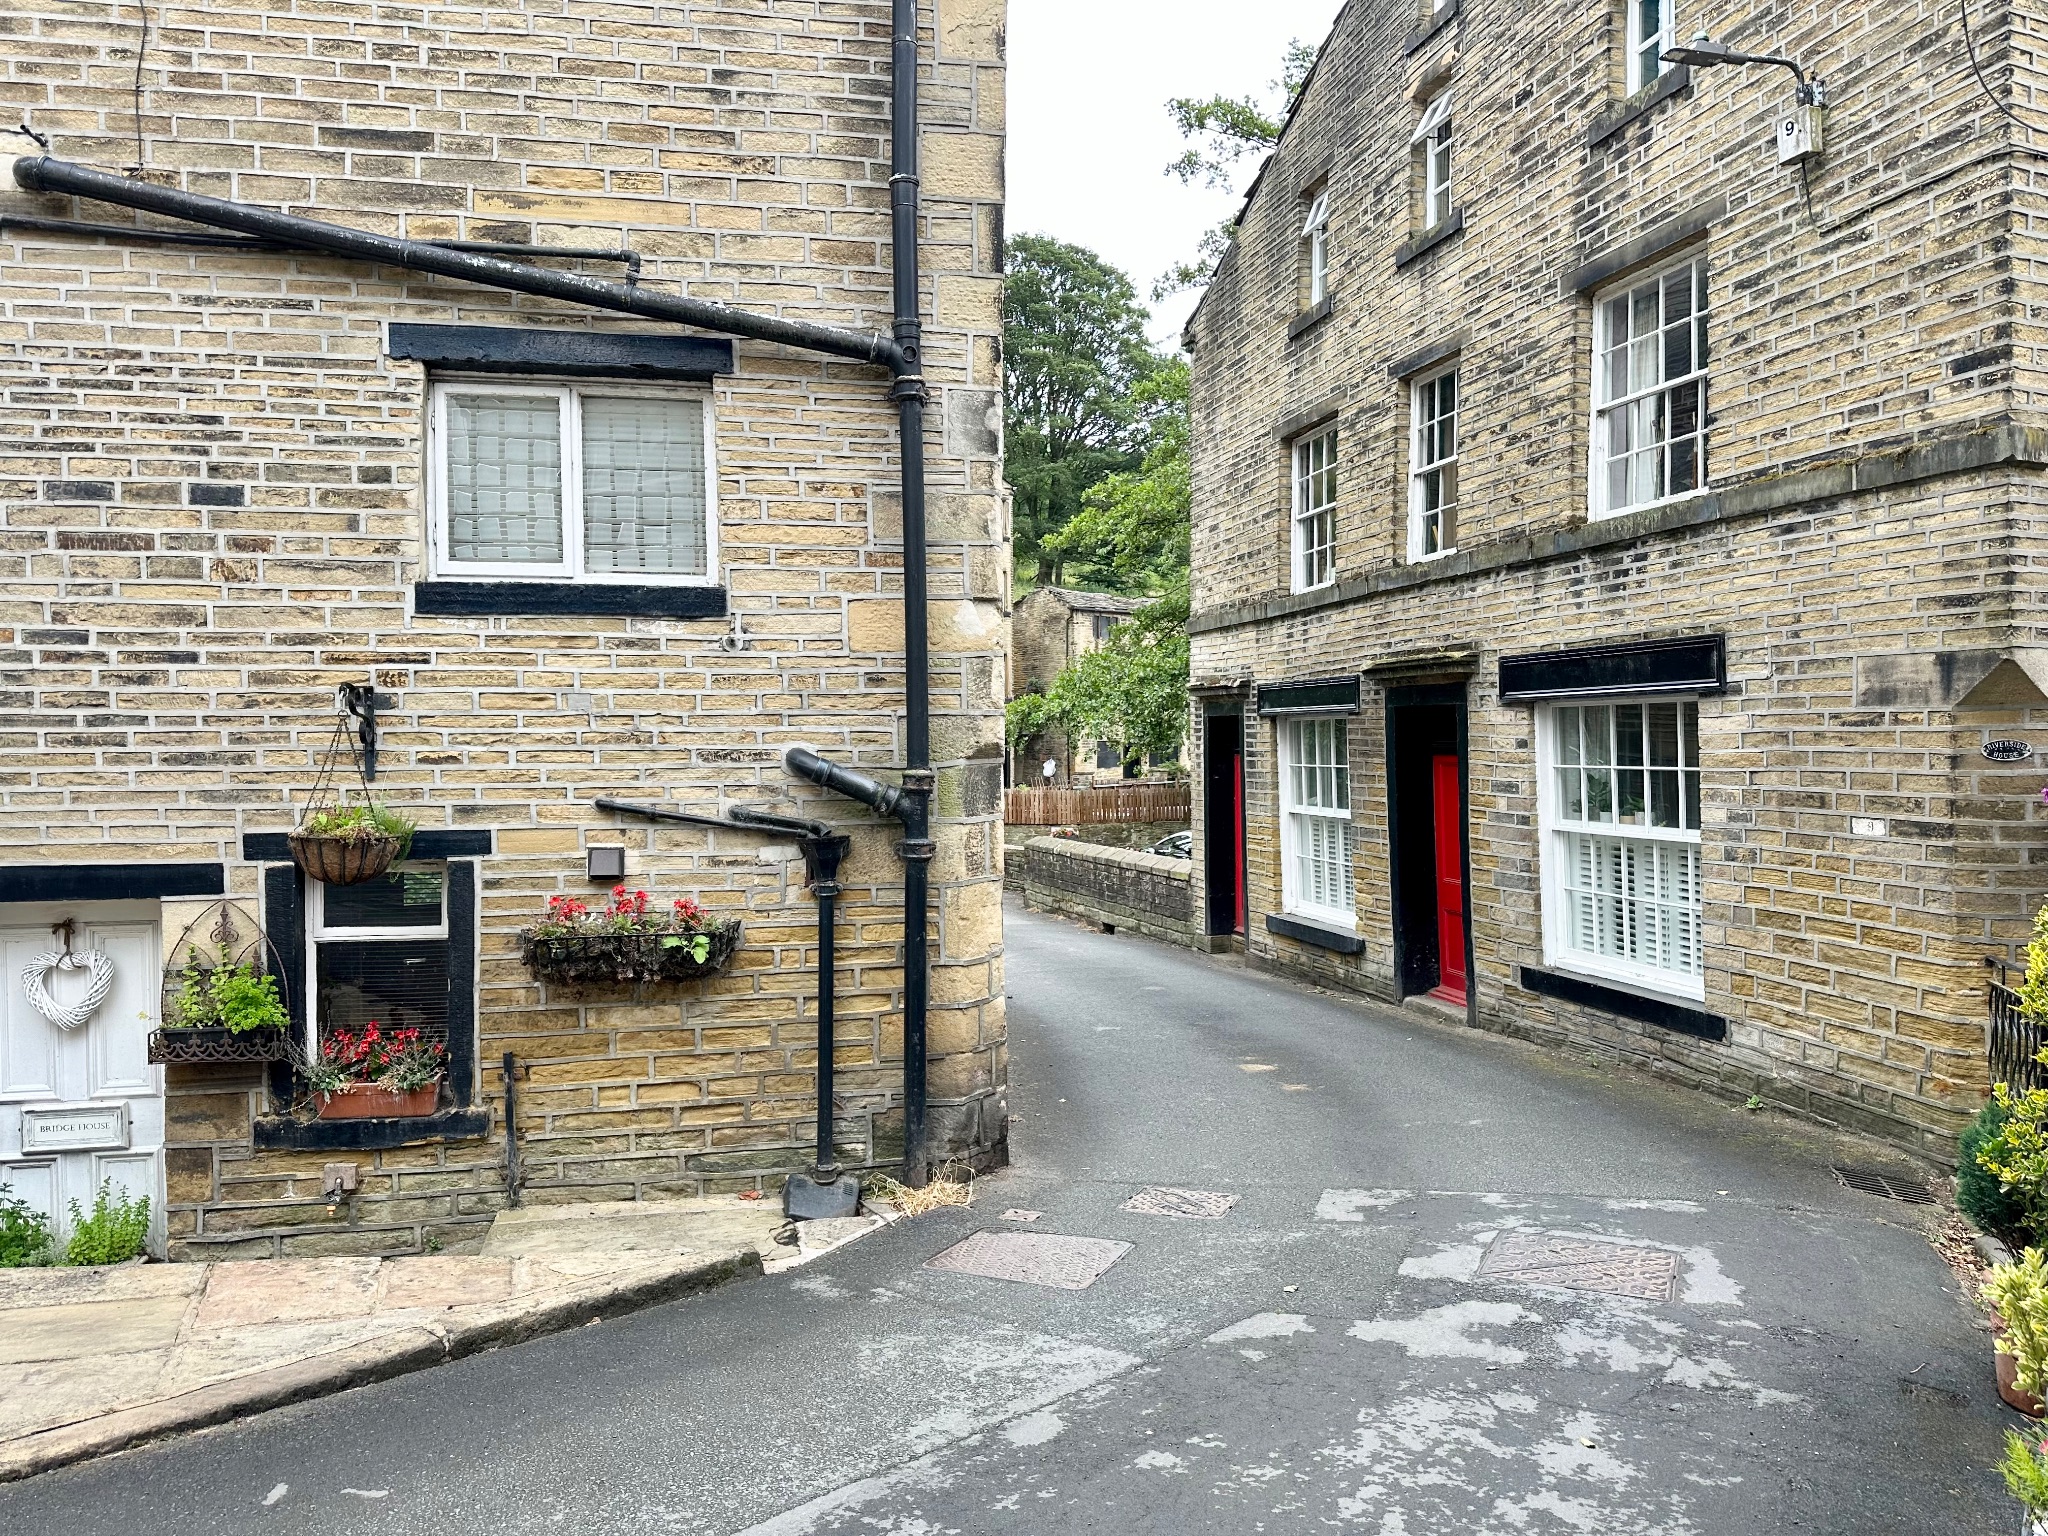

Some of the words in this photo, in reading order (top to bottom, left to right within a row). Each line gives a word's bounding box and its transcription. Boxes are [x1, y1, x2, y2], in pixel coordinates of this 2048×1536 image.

[1785, 120, 1795, 137] 9
[1986, 741, 2027, 751] RIVERSIDE
[1993, 751, 2020, 759] HOUSE
[40, 1123, 76, 1133] BRIDGE
[78, 1122, 111, 1131] HOUSE
